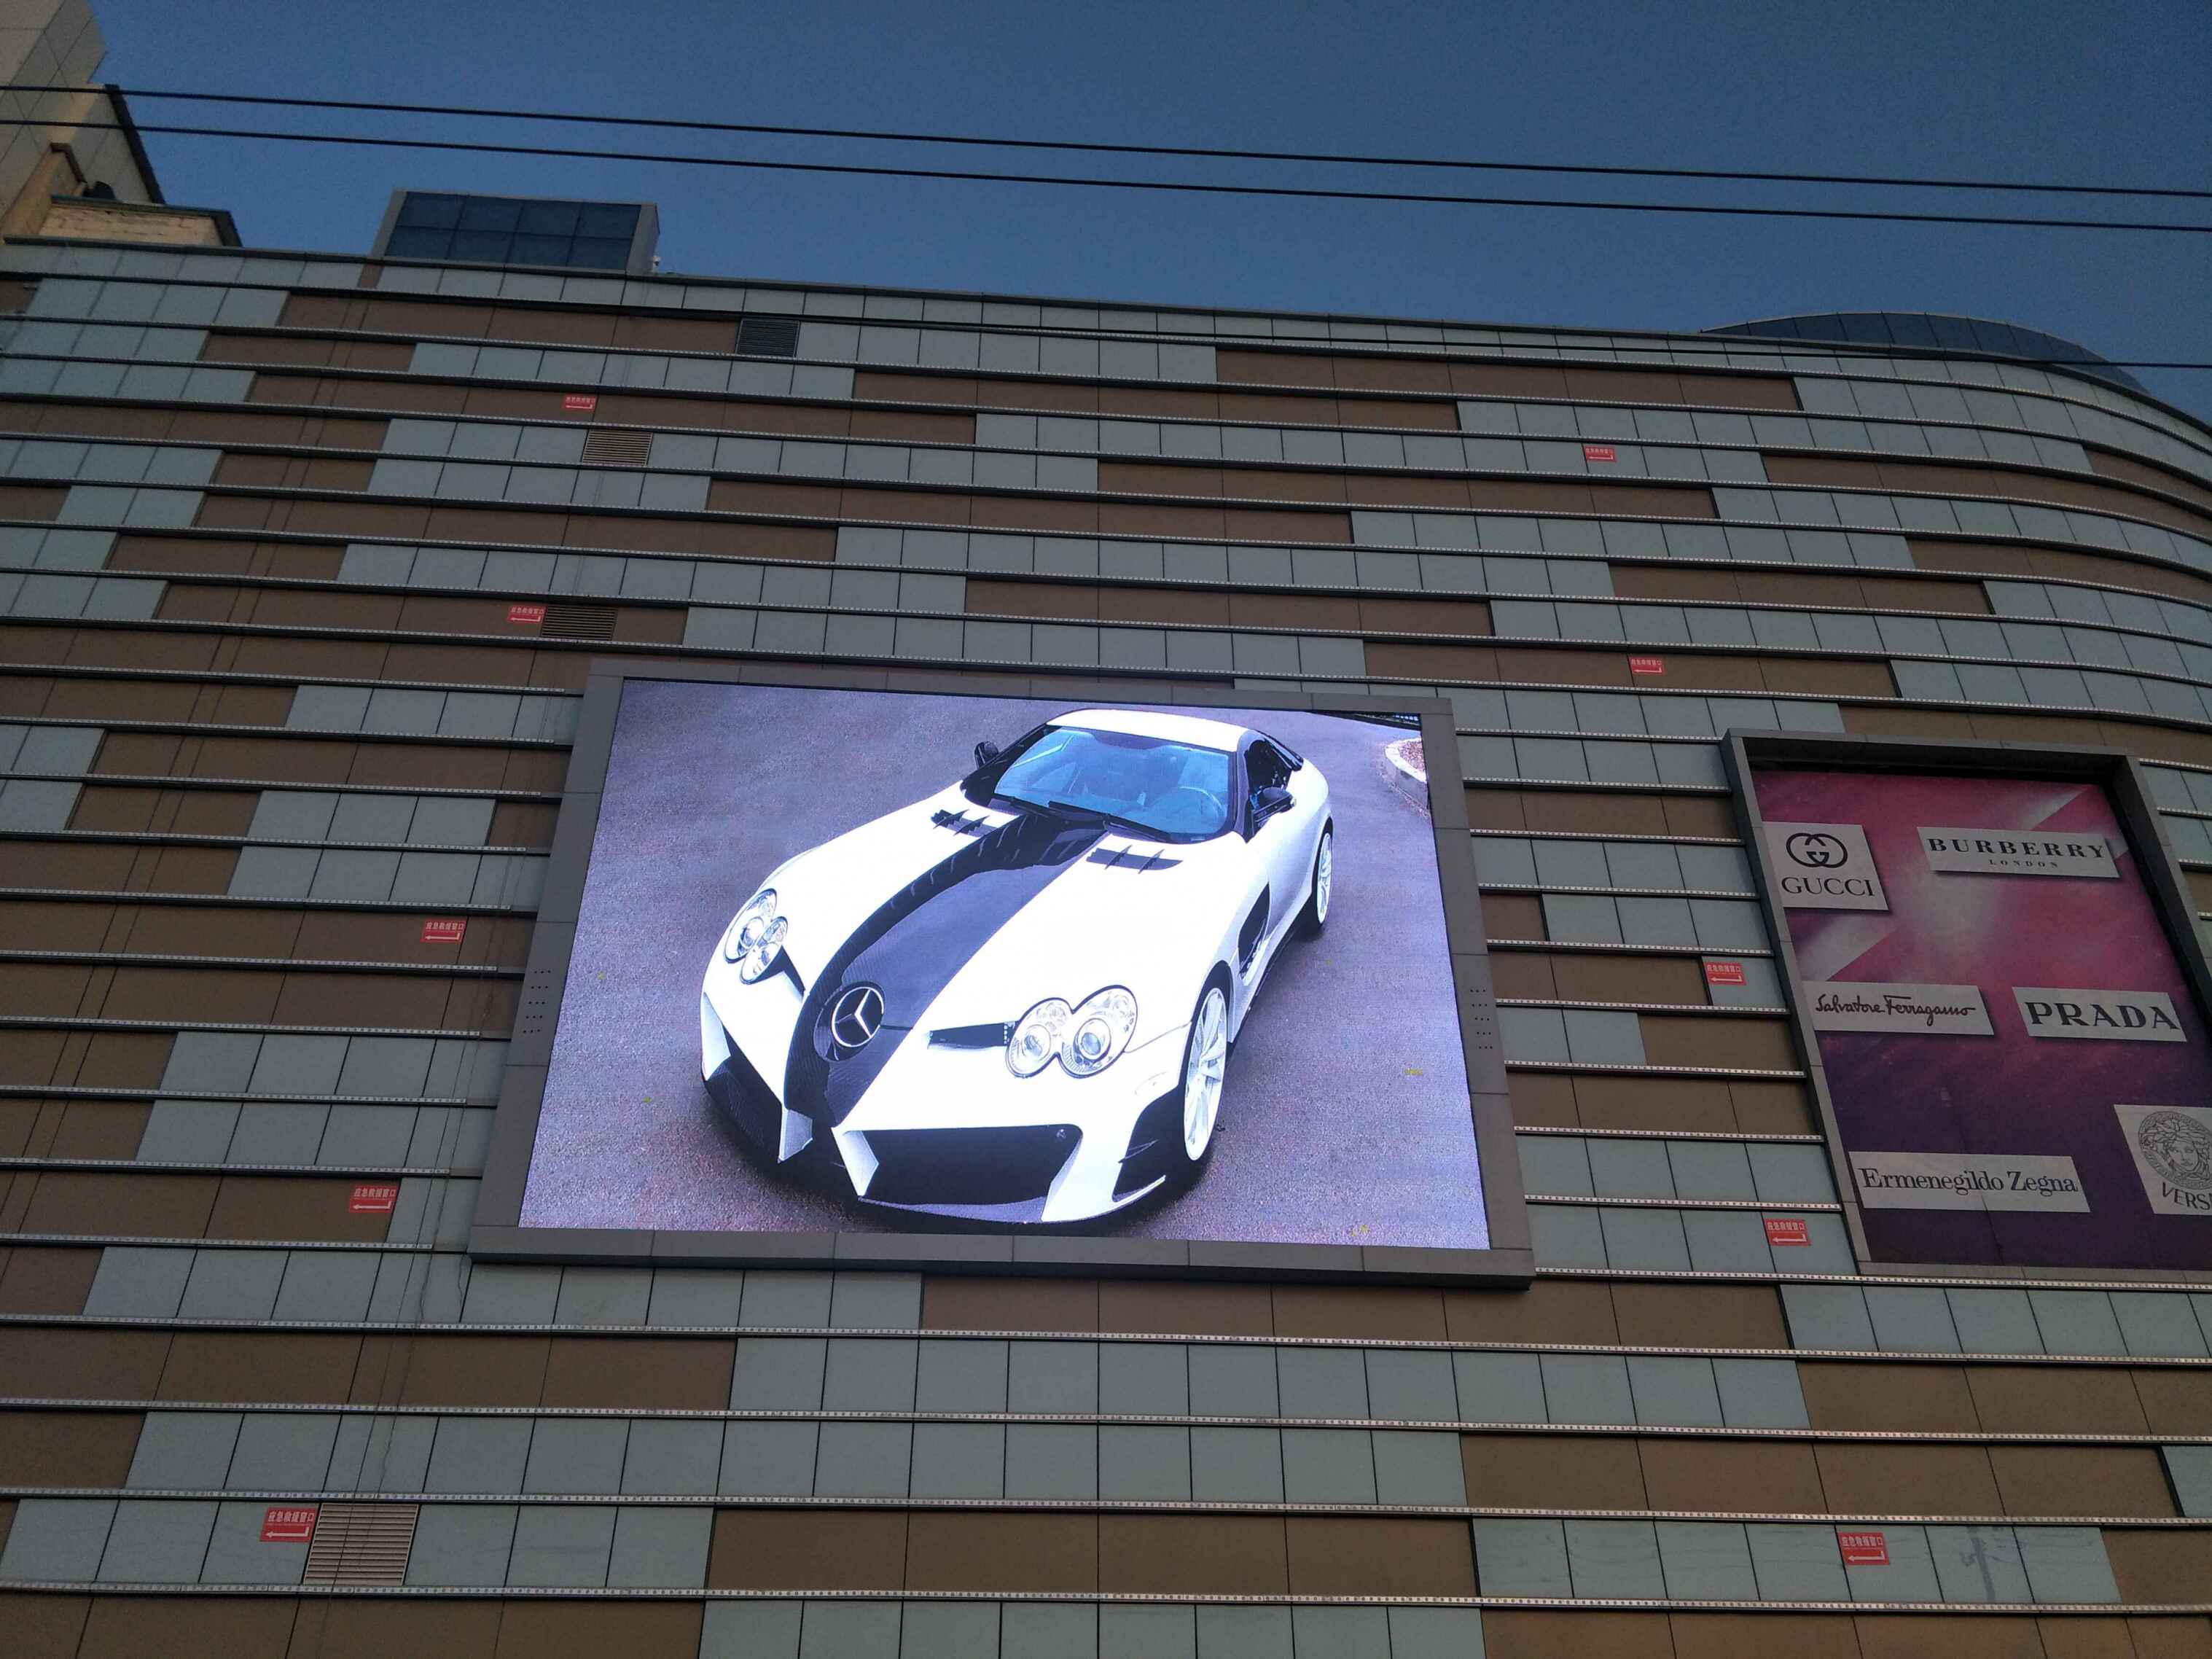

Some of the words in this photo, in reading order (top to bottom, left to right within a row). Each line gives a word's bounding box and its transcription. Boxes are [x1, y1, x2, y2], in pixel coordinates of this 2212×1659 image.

[1928, 838, 2106, 859] BURBERRY
[1989, 859, 2058, 868] LONDON
[1781, 877, 1875, 897] GUCCI
[1816, 994, 1884, 1015] Salvatore
[1884, 996, 1976, 1026] Ferragamo
[2025, 1002, 2181, 1030] PRADA
[1857, 1168, 2004, 1196] Ermenegildo
[2008, 1171, 2079, 1197] Zegna
[354, 1189, 396, 1198] 应急救援窗口
[268, 1511, 315, 1523] 应急救援窗口
